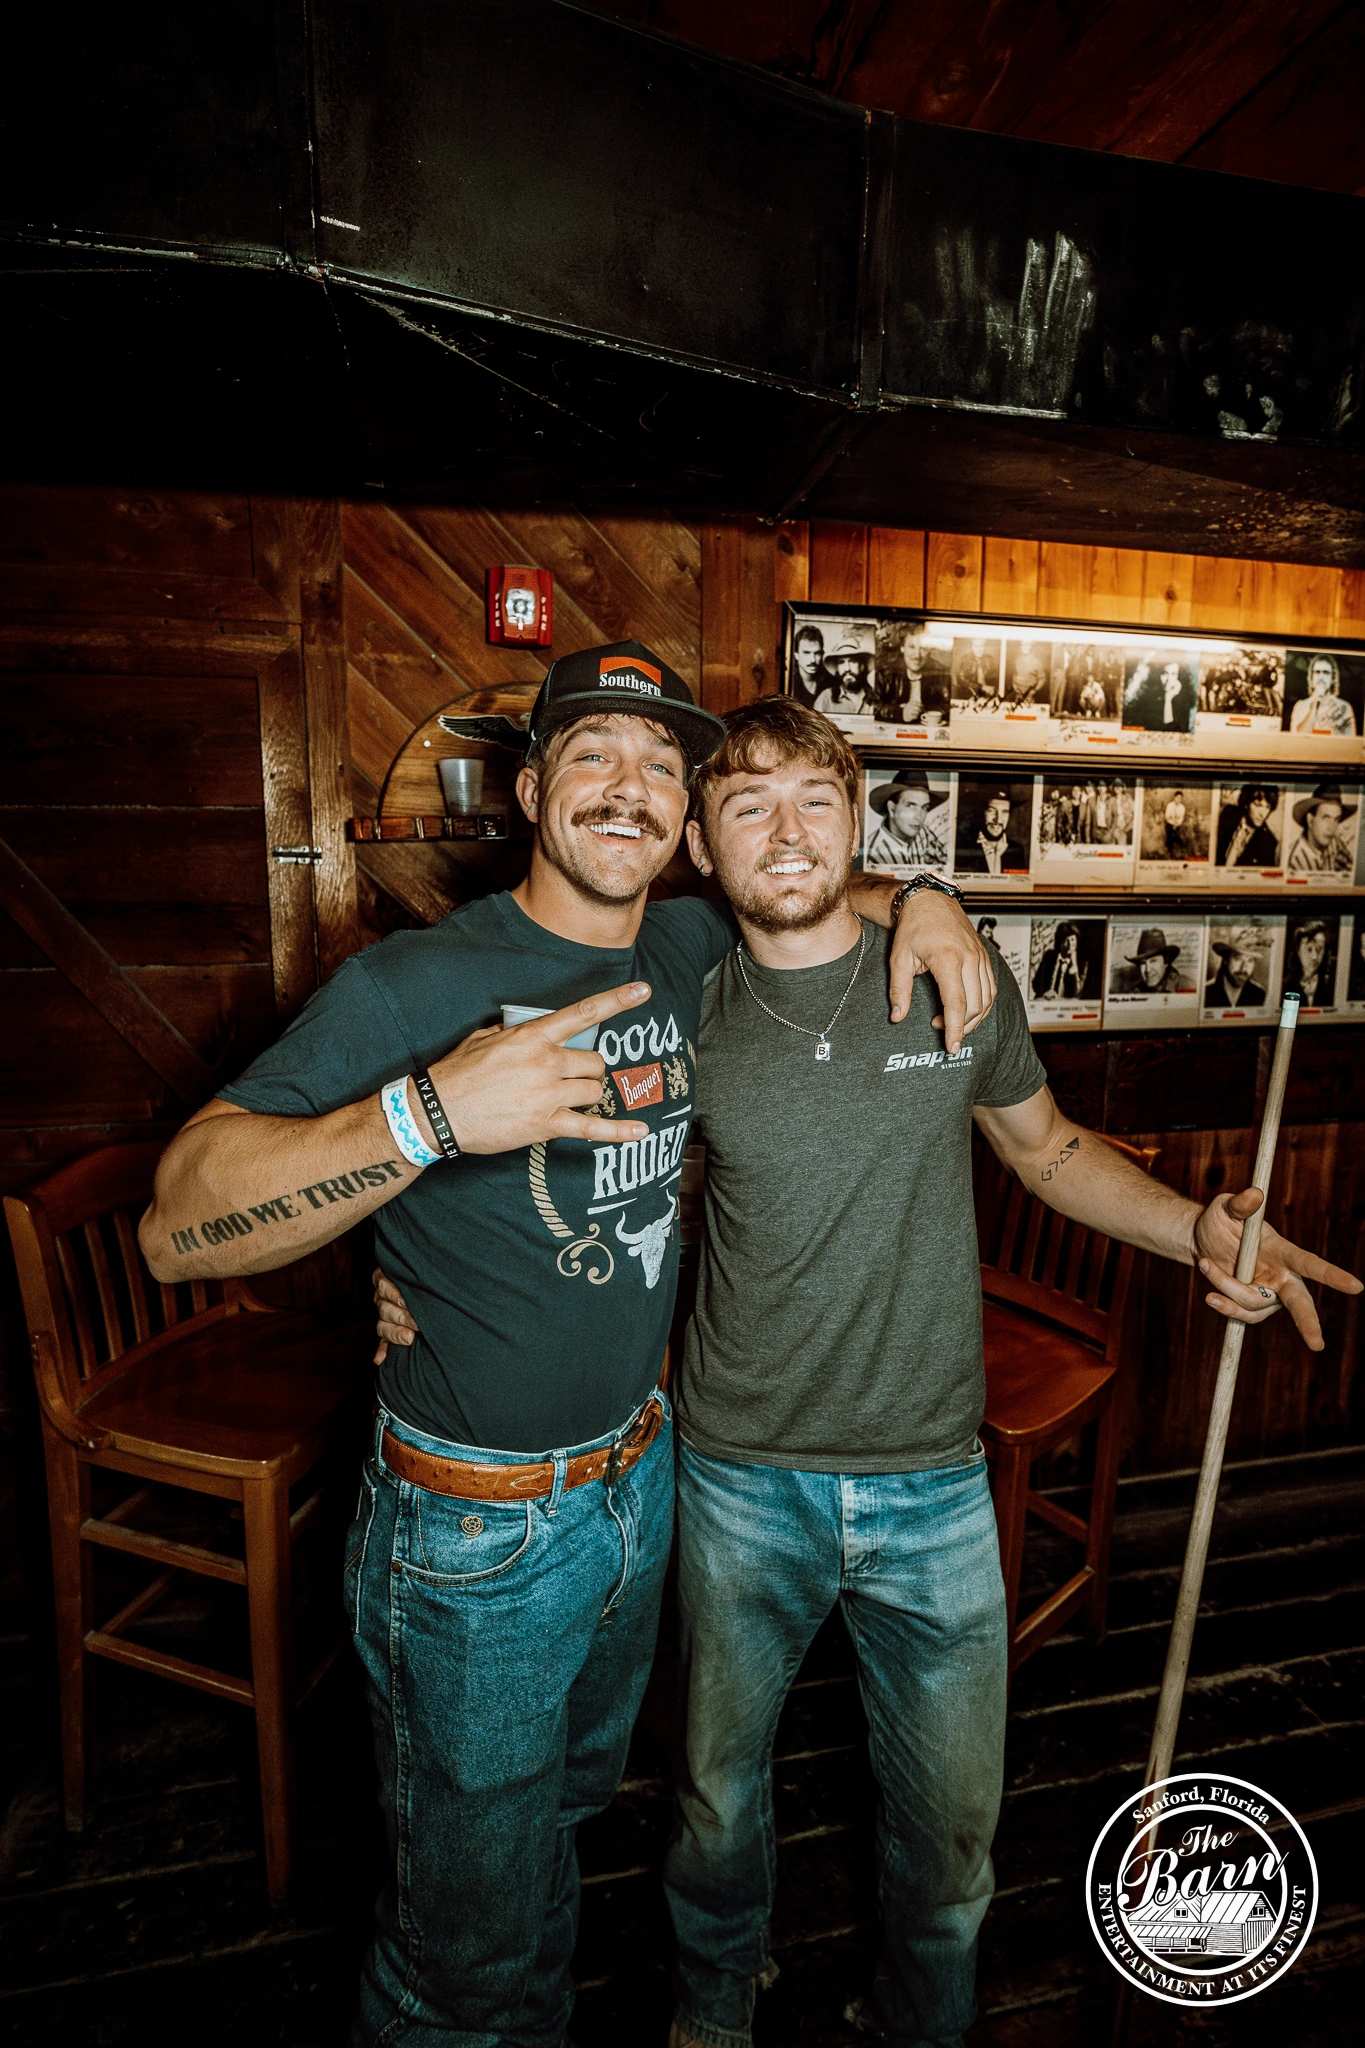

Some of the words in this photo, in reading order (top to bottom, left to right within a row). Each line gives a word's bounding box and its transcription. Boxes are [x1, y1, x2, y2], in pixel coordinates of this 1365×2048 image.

[599, 672, 662, 697] Southern
[598, 1013, 680, 1066] oors
[818, 1046, 826, 1056] B
[940, 1061, 960, 1070] SINCE
[620, 1067, 661, 1107] Banquet
[592, 1120, 689, 1200] RODEO
[170, 1226, 203, 1255] IN
[200, 1211, 254, 1247] GOD
[248, 1195, 302, 1225] WE
[297, 1160, 404, 1210] TRUST
